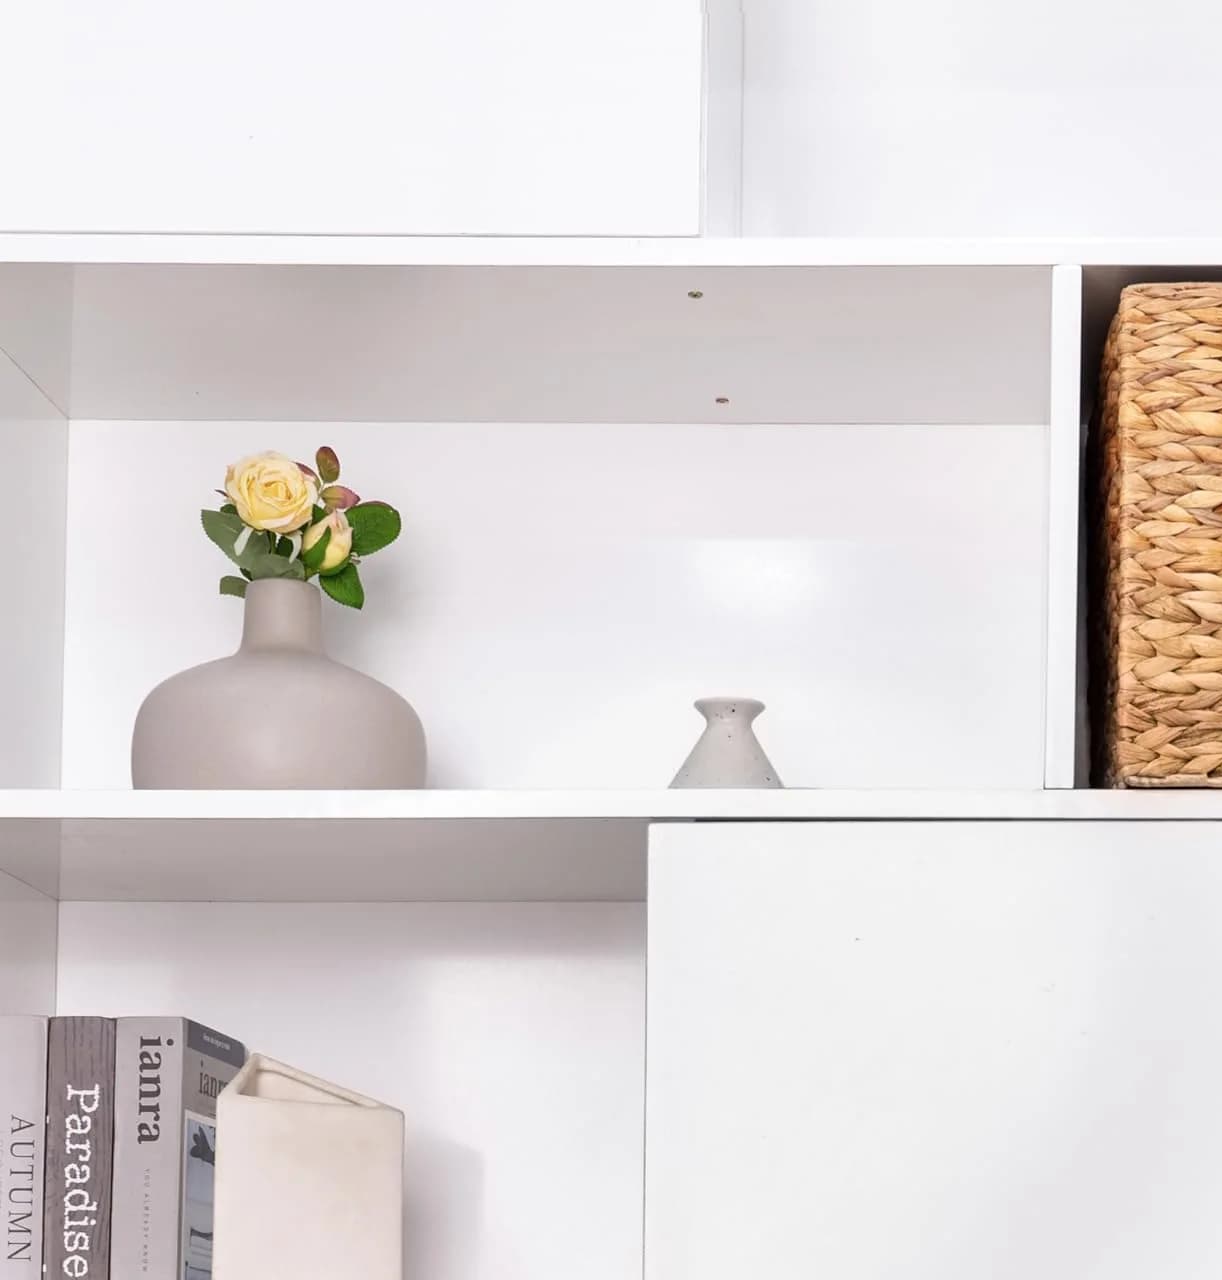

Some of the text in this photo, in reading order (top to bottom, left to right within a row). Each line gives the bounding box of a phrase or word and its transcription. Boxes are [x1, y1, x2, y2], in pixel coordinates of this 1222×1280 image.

[137, 1034, 175, 1145] ianra
[198, 1058, 229, 1099] ianr
[7, 1114, 36, 1262] AUTUMN
[62, 1083, 101, 1278] Paradise
